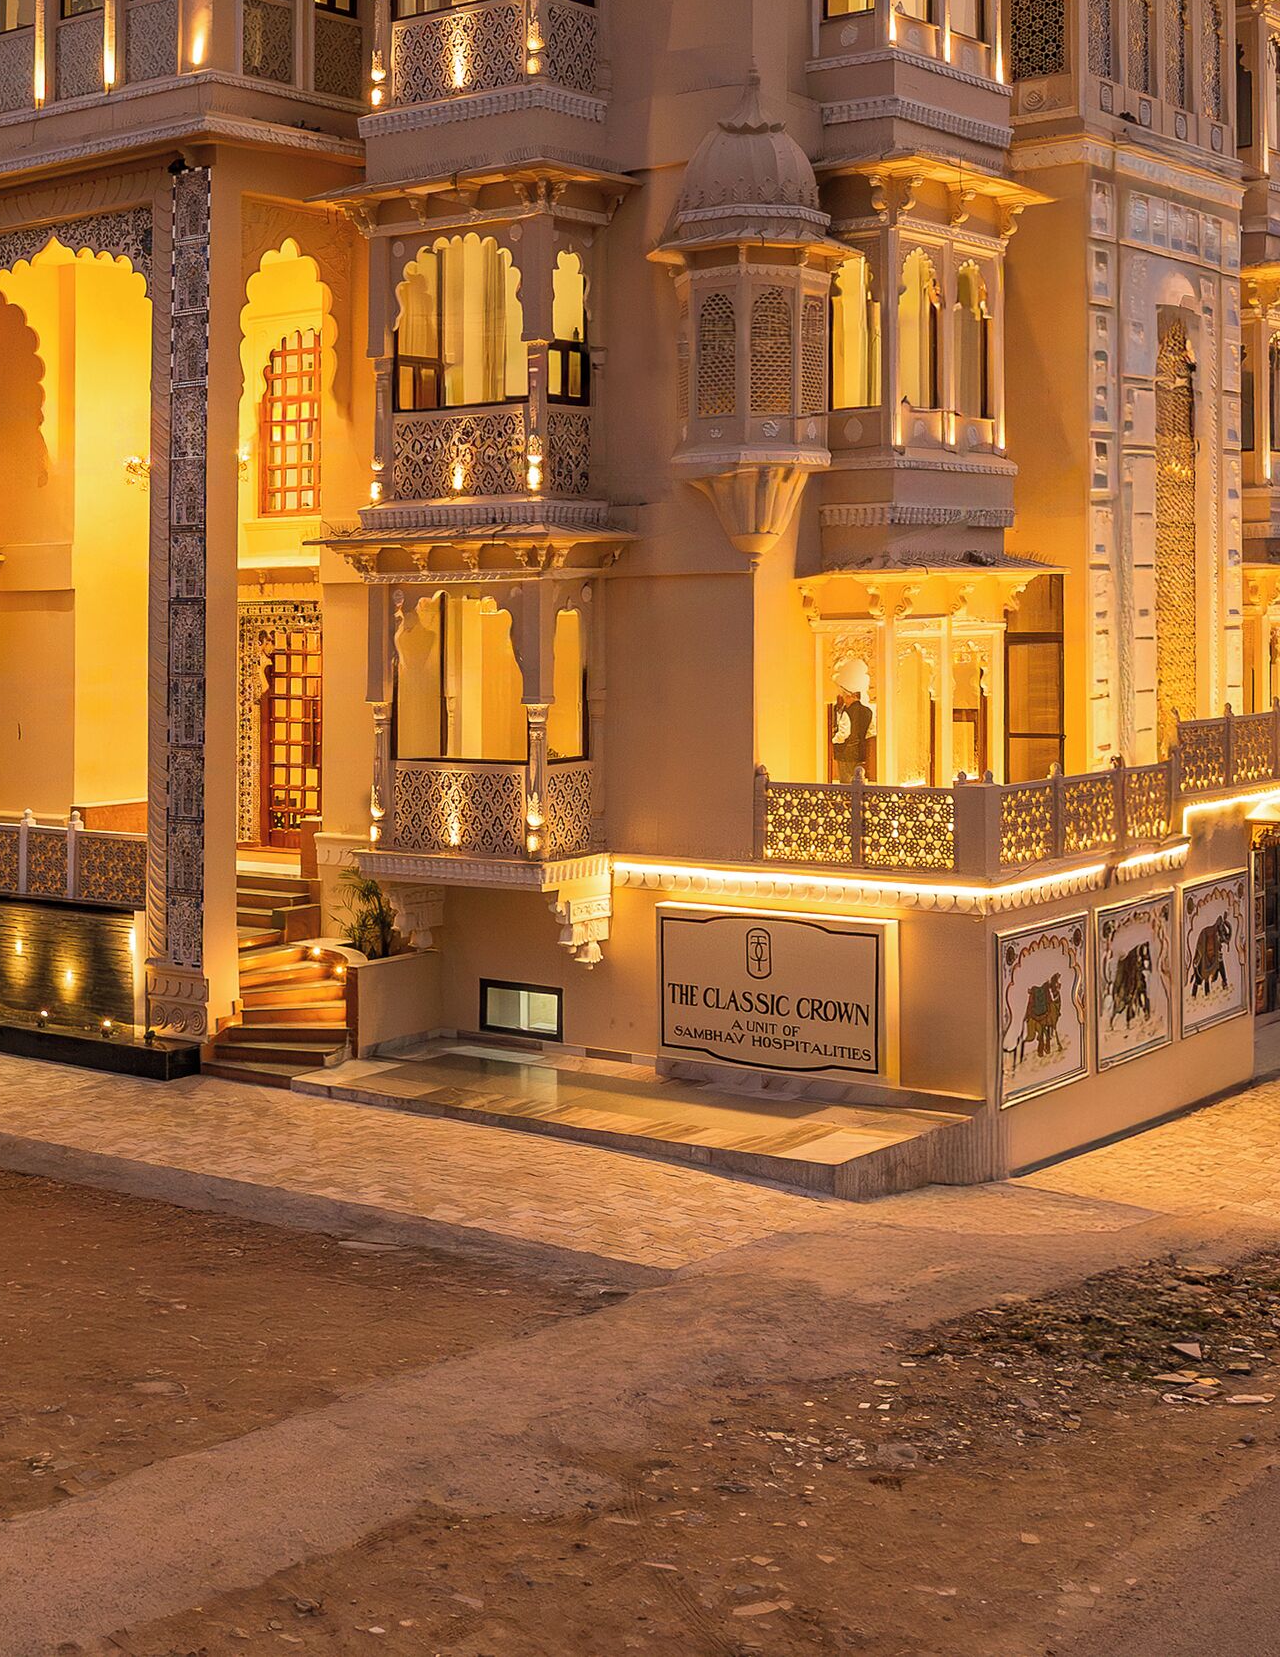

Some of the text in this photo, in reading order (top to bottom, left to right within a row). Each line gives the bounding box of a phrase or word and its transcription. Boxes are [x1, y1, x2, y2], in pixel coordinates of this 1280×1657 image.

[667, 982, 869, 1026] THE CLASSIC CROWN
[673, 1025, 872, 1062] SAMBHAV HOSPITALITIES
[731, 1020, 801, 1038] A UNIT OF
